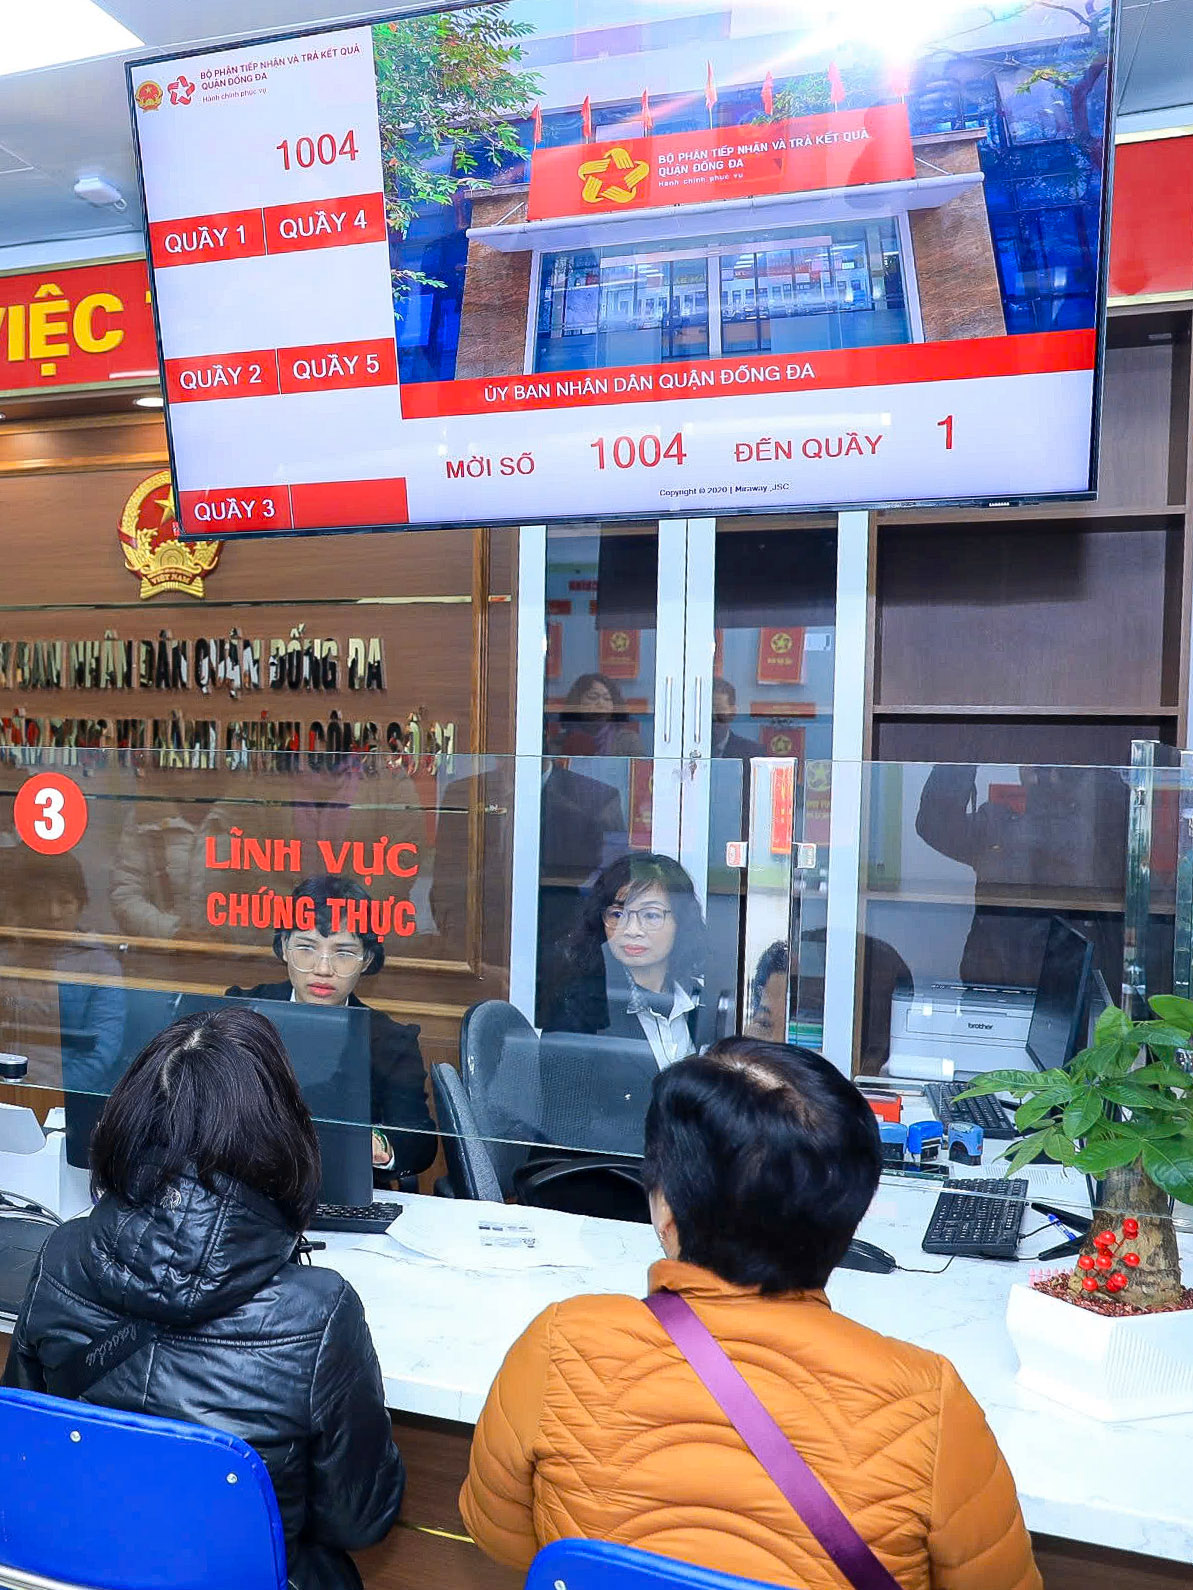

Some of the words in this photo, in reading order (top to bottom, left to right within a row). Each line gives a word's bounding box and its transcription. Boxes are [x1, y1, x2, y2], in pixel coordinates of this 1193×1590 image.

[201, 69, 212, 80] BỘ
[214, 65, 238, 77] PHẬN
[240, 62, 258, 72] TIẾP
[260, 57, 285, 69] NHẬN
[287, 54, 299, 64] VÀ
[301, 50, 319, 62] TRẢ
[321, 47, 337, 59] KẾT
[340, 43, 360, 55] QUẢ
[201, 79, 226, 90] QUẬN
[228, 74, 253, 86] ĐỐNG
[255, 72, 267, 81] ĐA
[276, 130, 359, 171] 1004
[658, 152, 674, 164] BỘ
[678, 149, 708, 161] PHẬN
[711, 145, 734, 157] TIẾP
[737, 142, 768, 155] NHẬN
[772, 138, 786, 151] VÀ
[789, 134, 813, 148] TRẢ
[815, 131, 839, 145] KẾT
[843, 127, 870, 143] QUẢ
[658, 164, 688, 177] QUẬN
[693, 160, 724, 172] ĐỐNG
[728, 159, 744, 169] ĐA
[164, 226, 228, 253] QUẦY
[235, 225, 246, 244] 1
[279, 211, 346, 239] QUẦY
[353, 210, 368, 229] 4
[179, 364, 242, 390] QUẦY
[248, 365, 262, 384] 2
[292, 354, 359, 380] QUẦY
[366, 354, 380, 373] 5
[484, 385, 509, 402] ỦY
[513, 384, 551, 400] BAN
[556, 378, 609, 398] NHÂN
[614, 374, 653, 393] DÂN
[659, 369, 715, 391] QUẬN
[720, 364, 782, 385] ĐỐNG
[786, 362, 815, 380] ĐA
[445, 456, 491, 479] MỜI
[500, 452, 535, 476] SỐ
[590, 432, 687, 471] 1004
[734, 437, 792, 463] ĐẾN
[801, 432, 883, 459] QUẦY
[937, 414, 955, 451] 1
[659, 487, 697, 498] Copyright
[707, 486, 728, 494] 2020
[193, 498, 256, 521] QUẦY
[262, 499, 276, 518] 3
[139, 628, 189, 690] DÂN
[33, 787, 66, 841] 3
[205, 826, 302, 873] LĨNH
[317, 835, 419, 886] VỰC
[207, 885, 316, 932] CHỨNG
[326, 895, 417, 944] THỰC
[968, 1022, 993, 1030] brother
